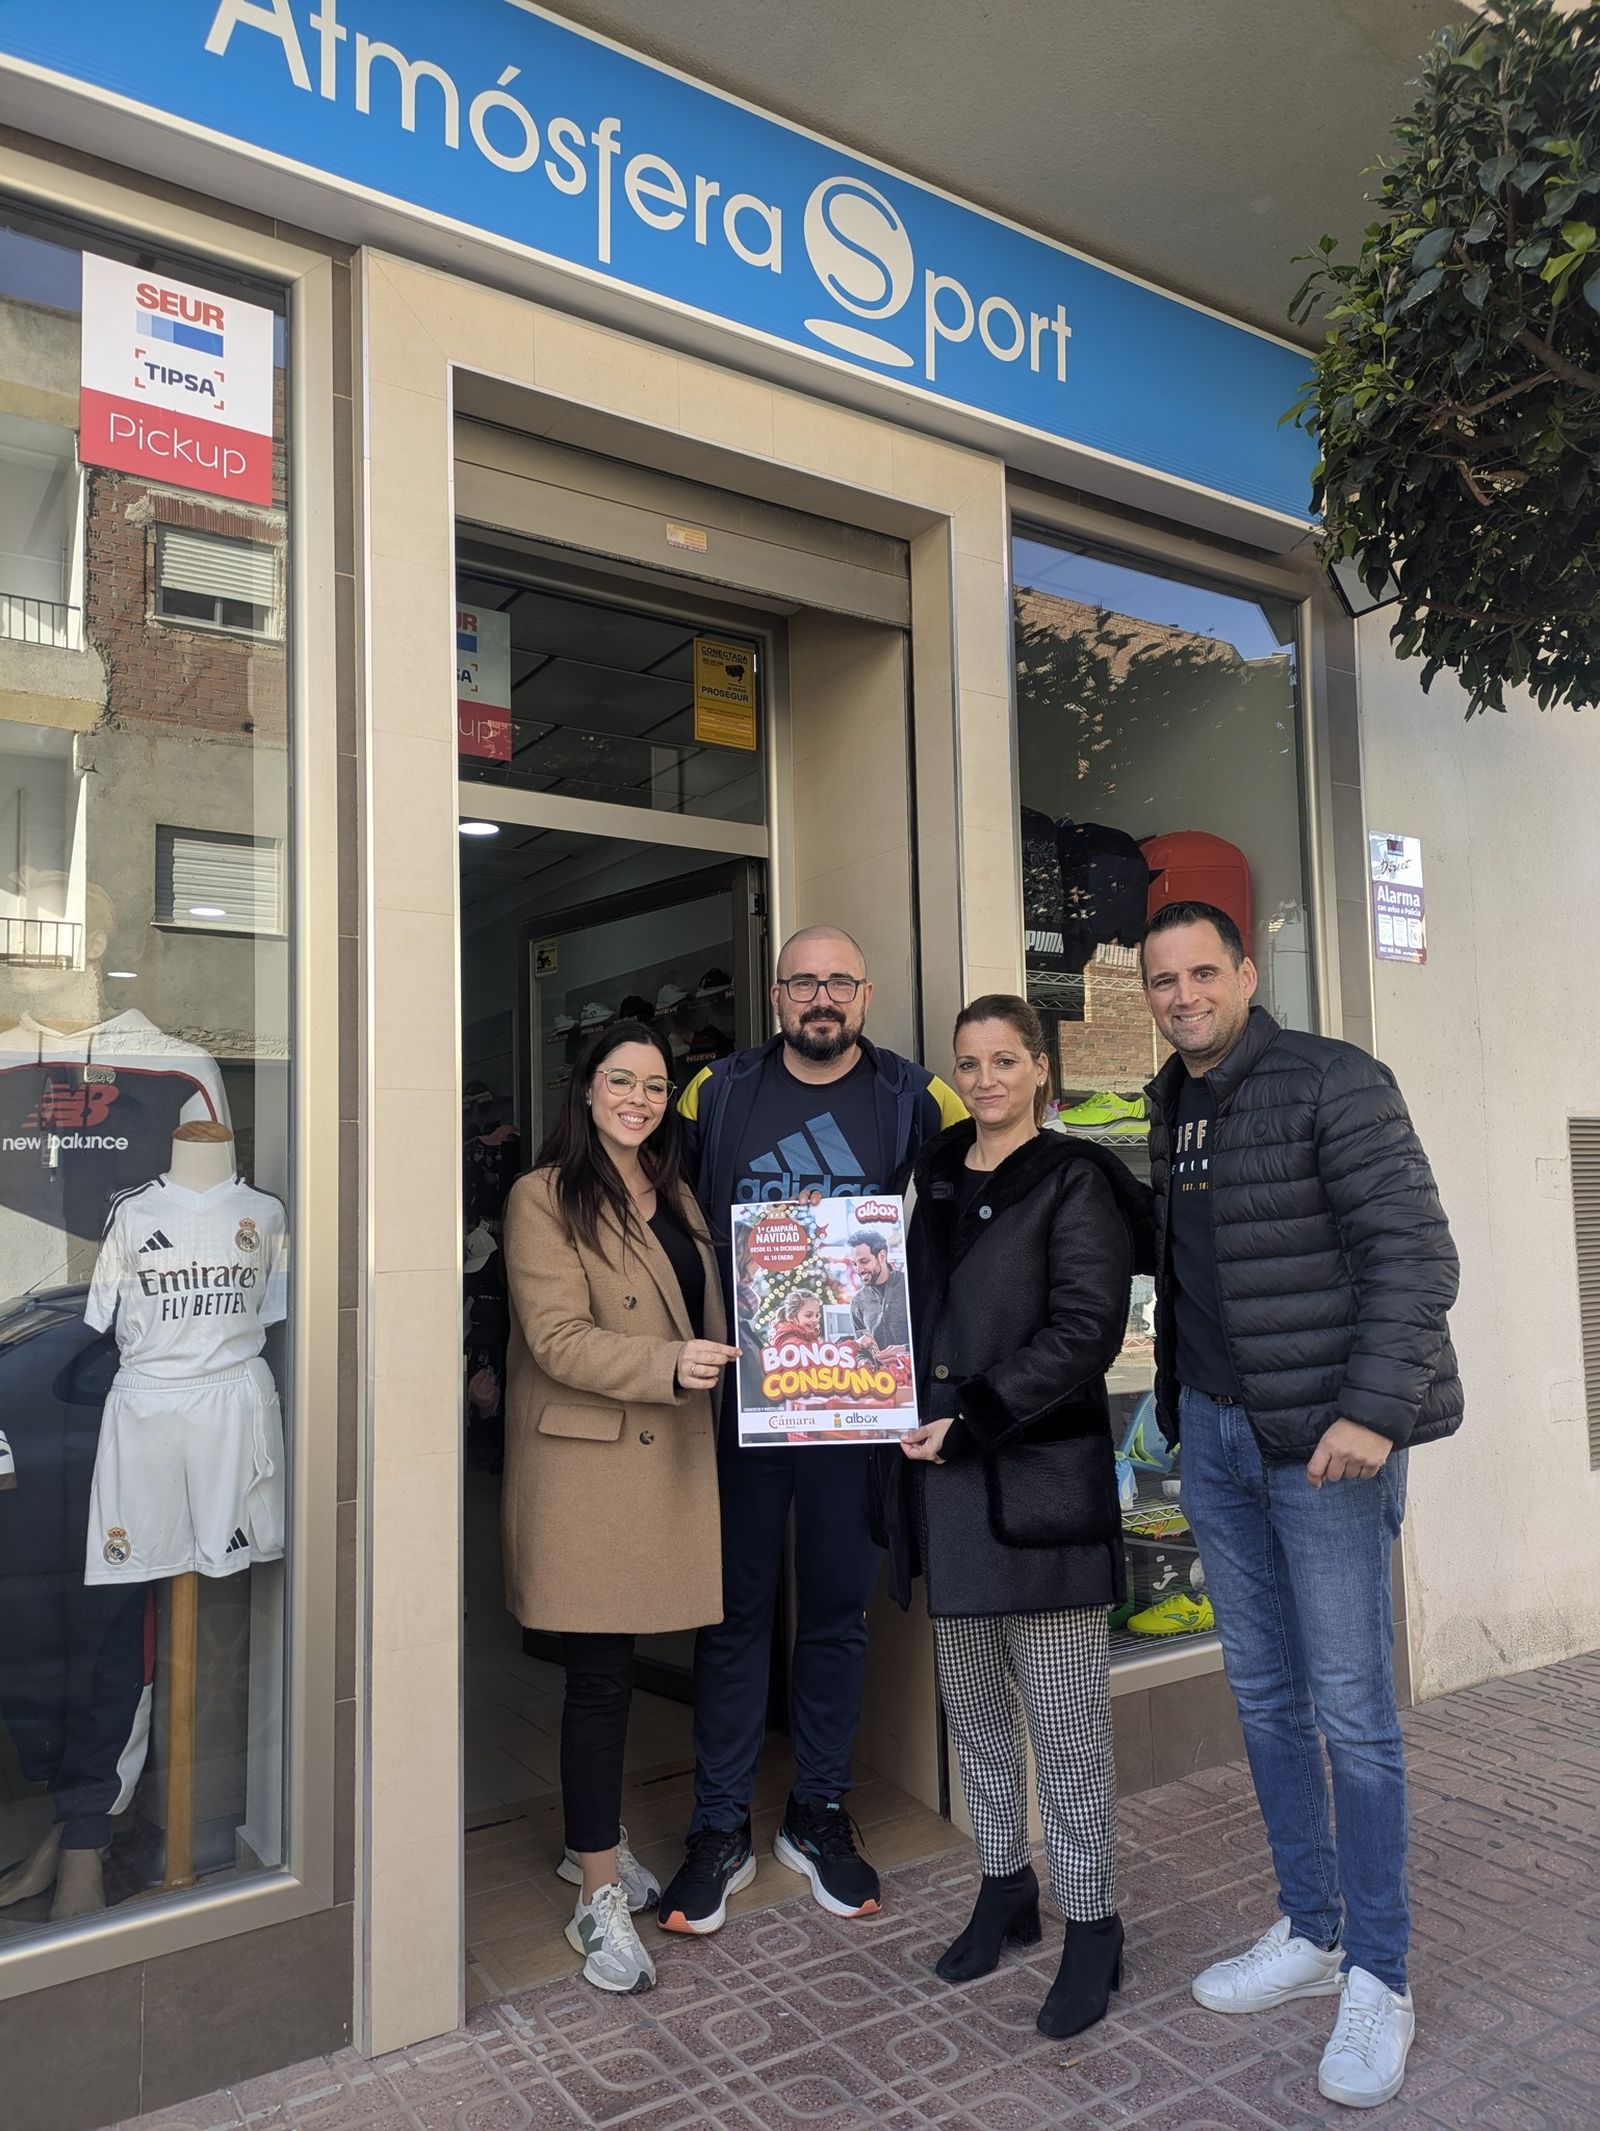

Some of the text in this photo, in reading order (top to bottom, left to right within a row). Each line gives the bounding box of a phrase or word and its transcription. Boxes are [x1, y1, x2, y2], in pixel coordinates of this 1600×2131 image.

[204, 0, 1072, 382] Atmósfera Sport
[136, 283, 225, 331] SEUR
[144, 361, 216, 398] TIPSA
[110, 412, 247, 478] Pickup
[701, 686, 749, 703] PROSEGUR
[1377, 885, 1421, 908] Alarma
[1025, 929, 1065, 954] PUMA
[1095, 942, 1138, 968] PUMA
[2, 1132, 129, 1151] new balance
[736, 1172, 881, 1204] adidas
[857, 1201, 897, 1219] albox
[755, 1232, 800, 1244] NAVIDAD
[765, 1223, 799, 1233] CAMPAÑA
[137, 1261, 259, 1297] Emirates
[162, 1292, 248, 1322] FLY BETTER
[763, 1345, 855, 1372] BONOS
[762, 1367, 896, 1397] CONSUMO
[769, 1415, 815, 1429] Cámara
[845, 1412, 879, 1424] albox
